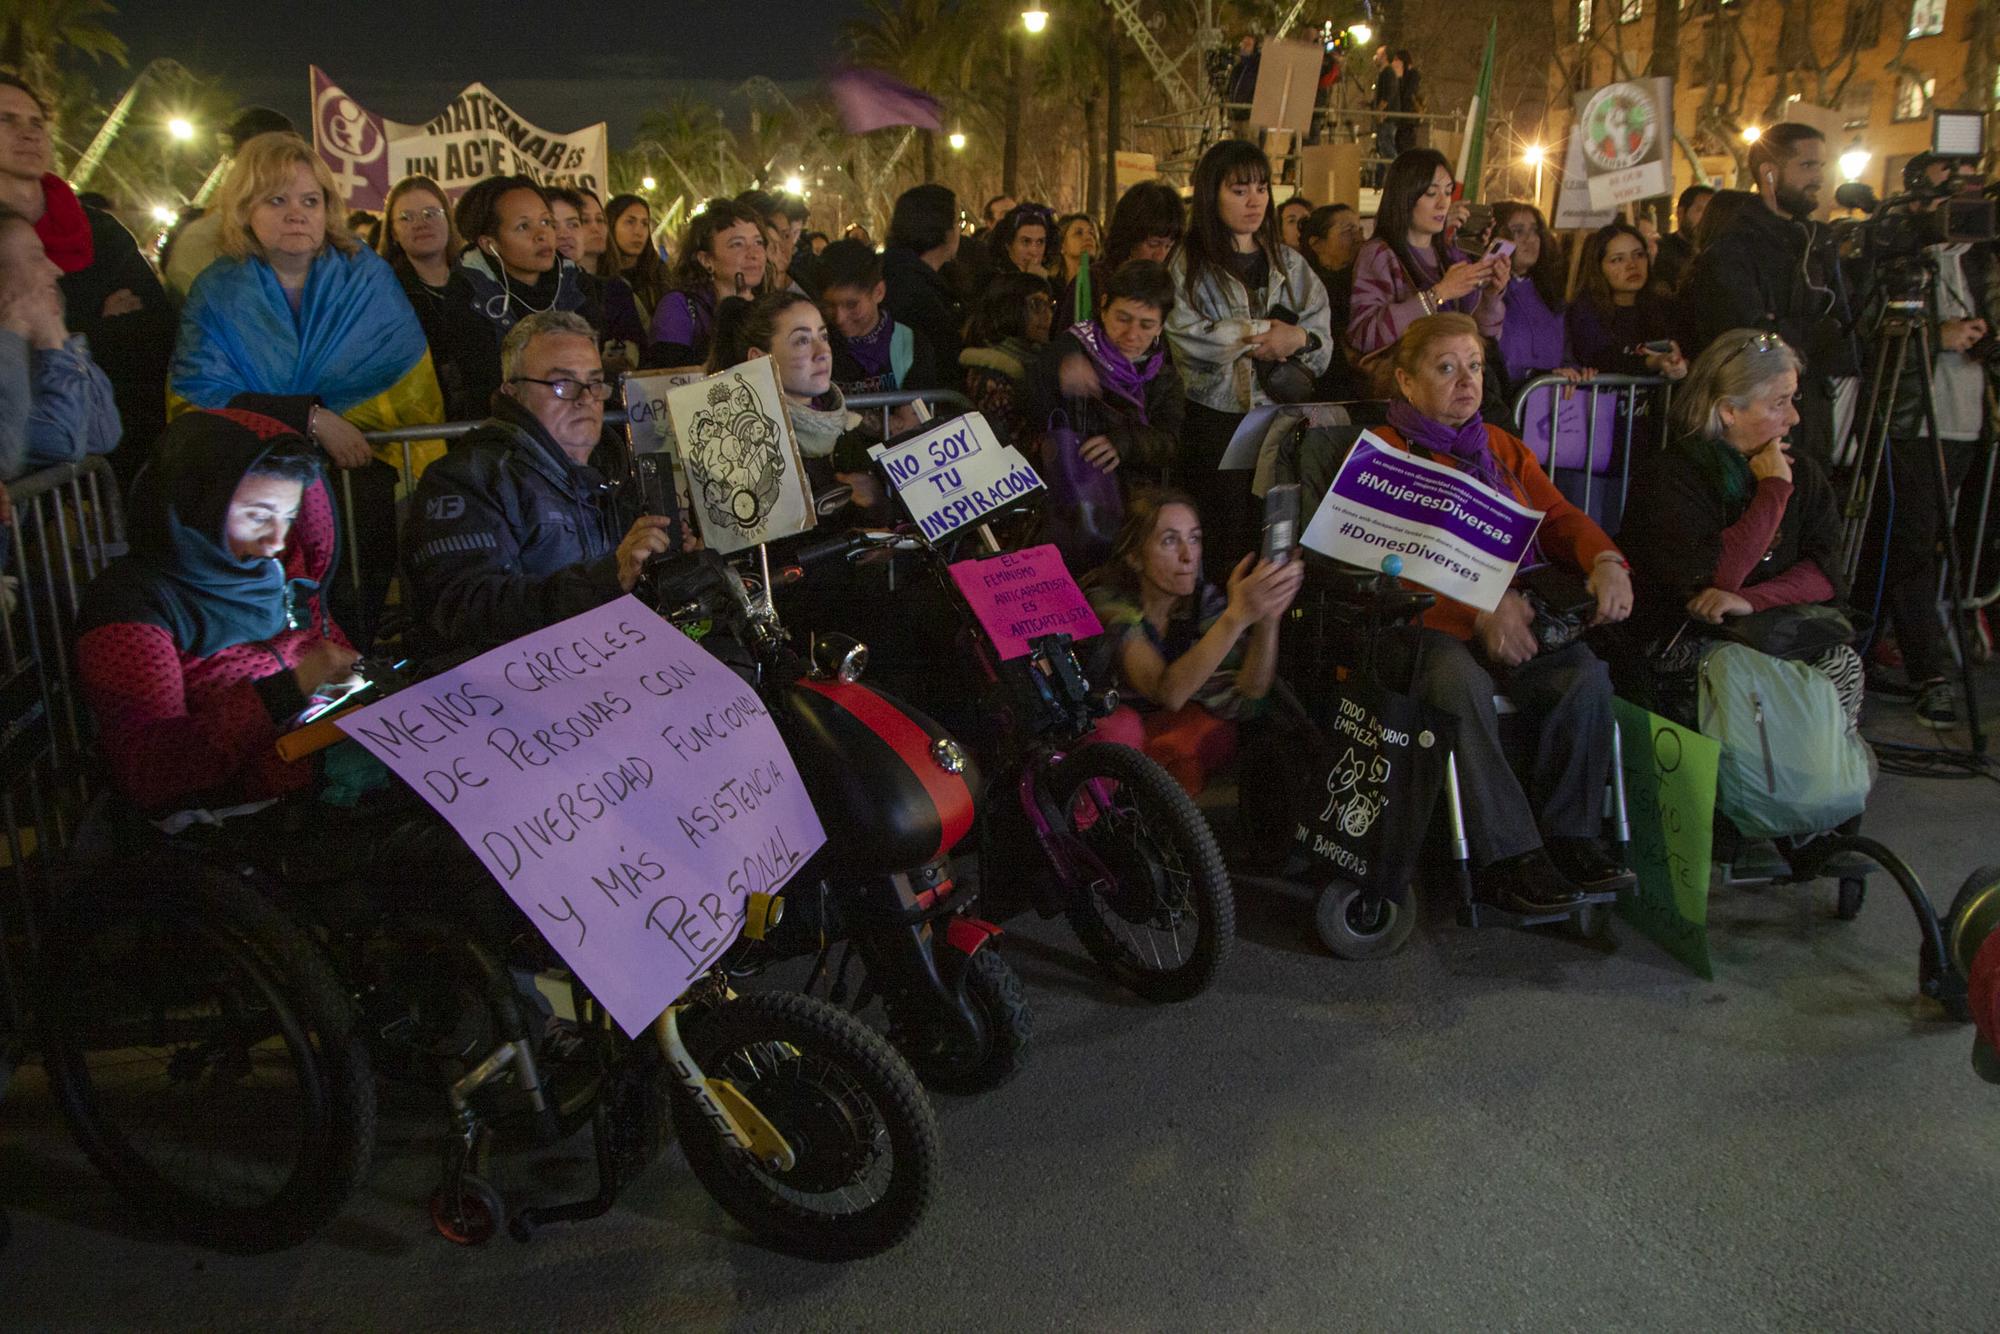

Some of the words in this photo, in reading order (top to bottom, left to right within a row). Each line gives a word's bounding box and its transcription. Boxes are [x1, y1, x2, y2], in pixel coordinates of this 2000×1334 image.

[446, 138, 505, 181] ACTE
[886, 454, 920, 485] NO
[928, 429, 971, 467] SOY
[928, 467, 962, 494] TU
[919, 463, 1039, 540] INSPIRACIÓN
[1356, 471, 1513, 544] #MujeresDiversas
[983, 566, 1037, 588] FEMINISMO
[1001, 554, 1020, 568] EL
[1339, 521, 1481, 583] #DonesDiverses
[1021, 601, 1038, 614] ES
[358, 681, 504, 759] MENOS
[504, 621, 646, 693] CÁRCELES
[1339, 698, 1366, 721] TODO
[423, 756, 490, 805] DE
[487, 690, 632, 772] PERSONAS
[639, 659, 697, 698] CON
[1334, 715, 1379, 750] EMPIEZA
[482, 755, 655, 881] DIVERSIDAD
[538, 894, 588, 948] Y
[591, 846, 666, 908] MÁS
[676, 759, 785, 848] ASISTENCIA
[645, 825, 800, 967] PERSONAL
